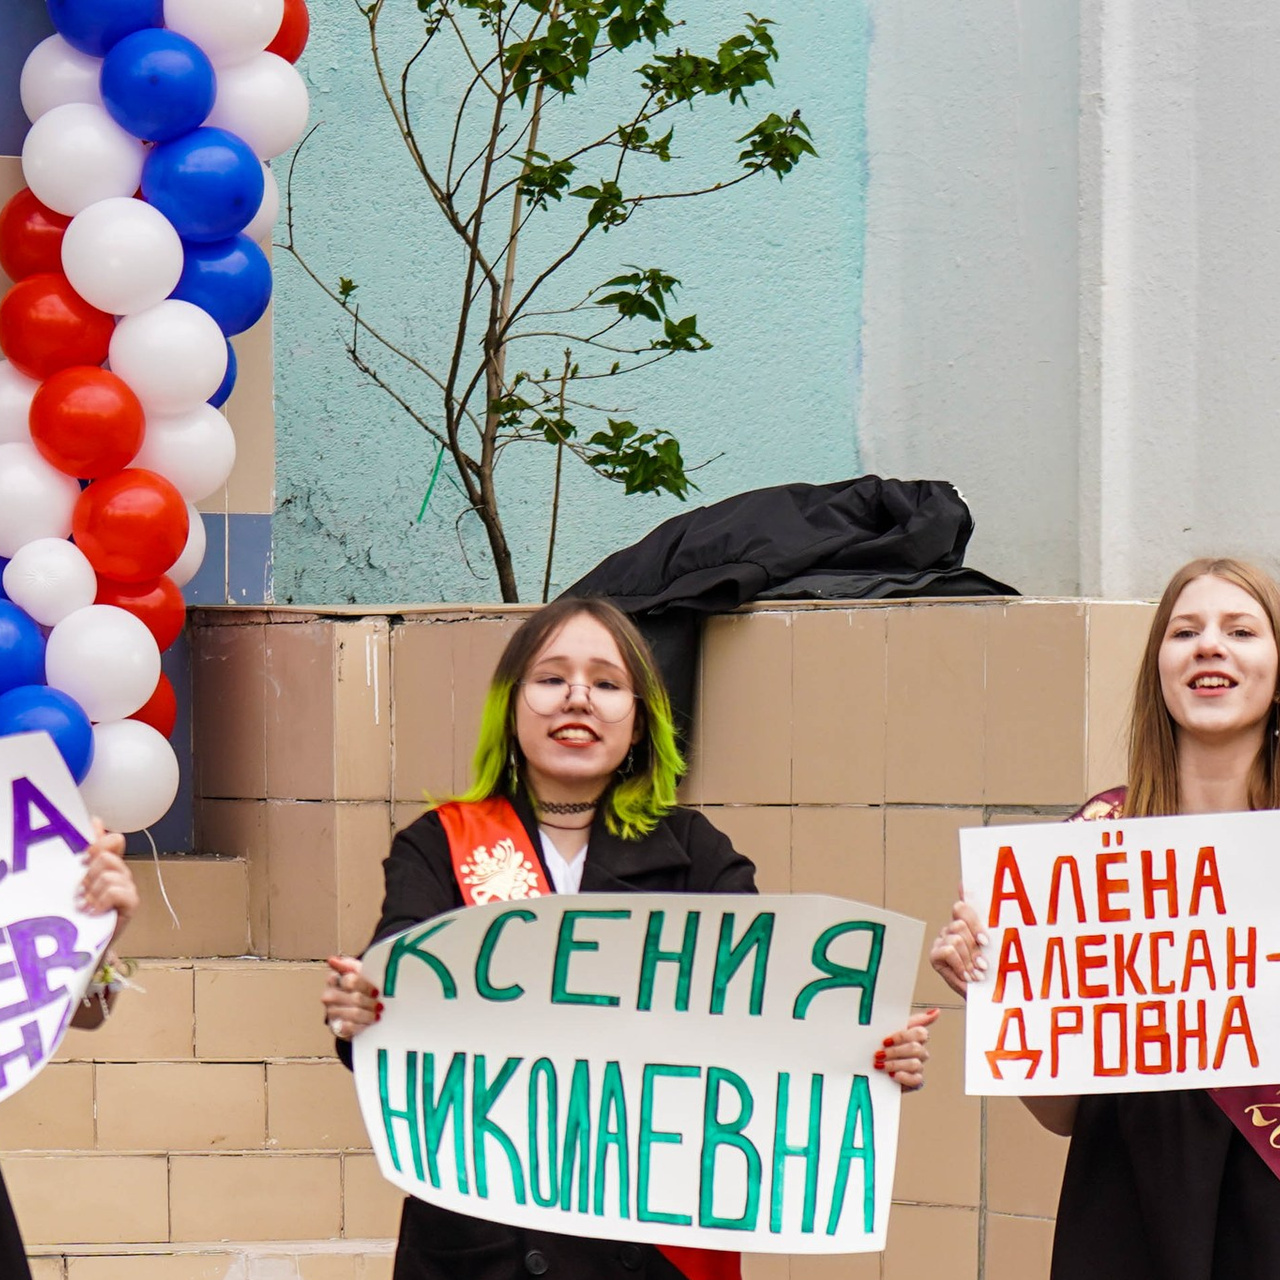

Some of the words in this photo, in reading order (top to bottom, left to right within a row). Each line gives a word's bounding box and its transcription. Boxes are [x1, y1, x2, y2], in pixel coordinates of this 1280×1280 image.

[987, 830, 1227, 928] АЛЁНА
[383, 909, 887, 1026] КСЕНИЯ
[984, 995, 1260, 1080] ДРОВНА
[377, 1048, 876, 1237] НИКОЛАЕВНА
